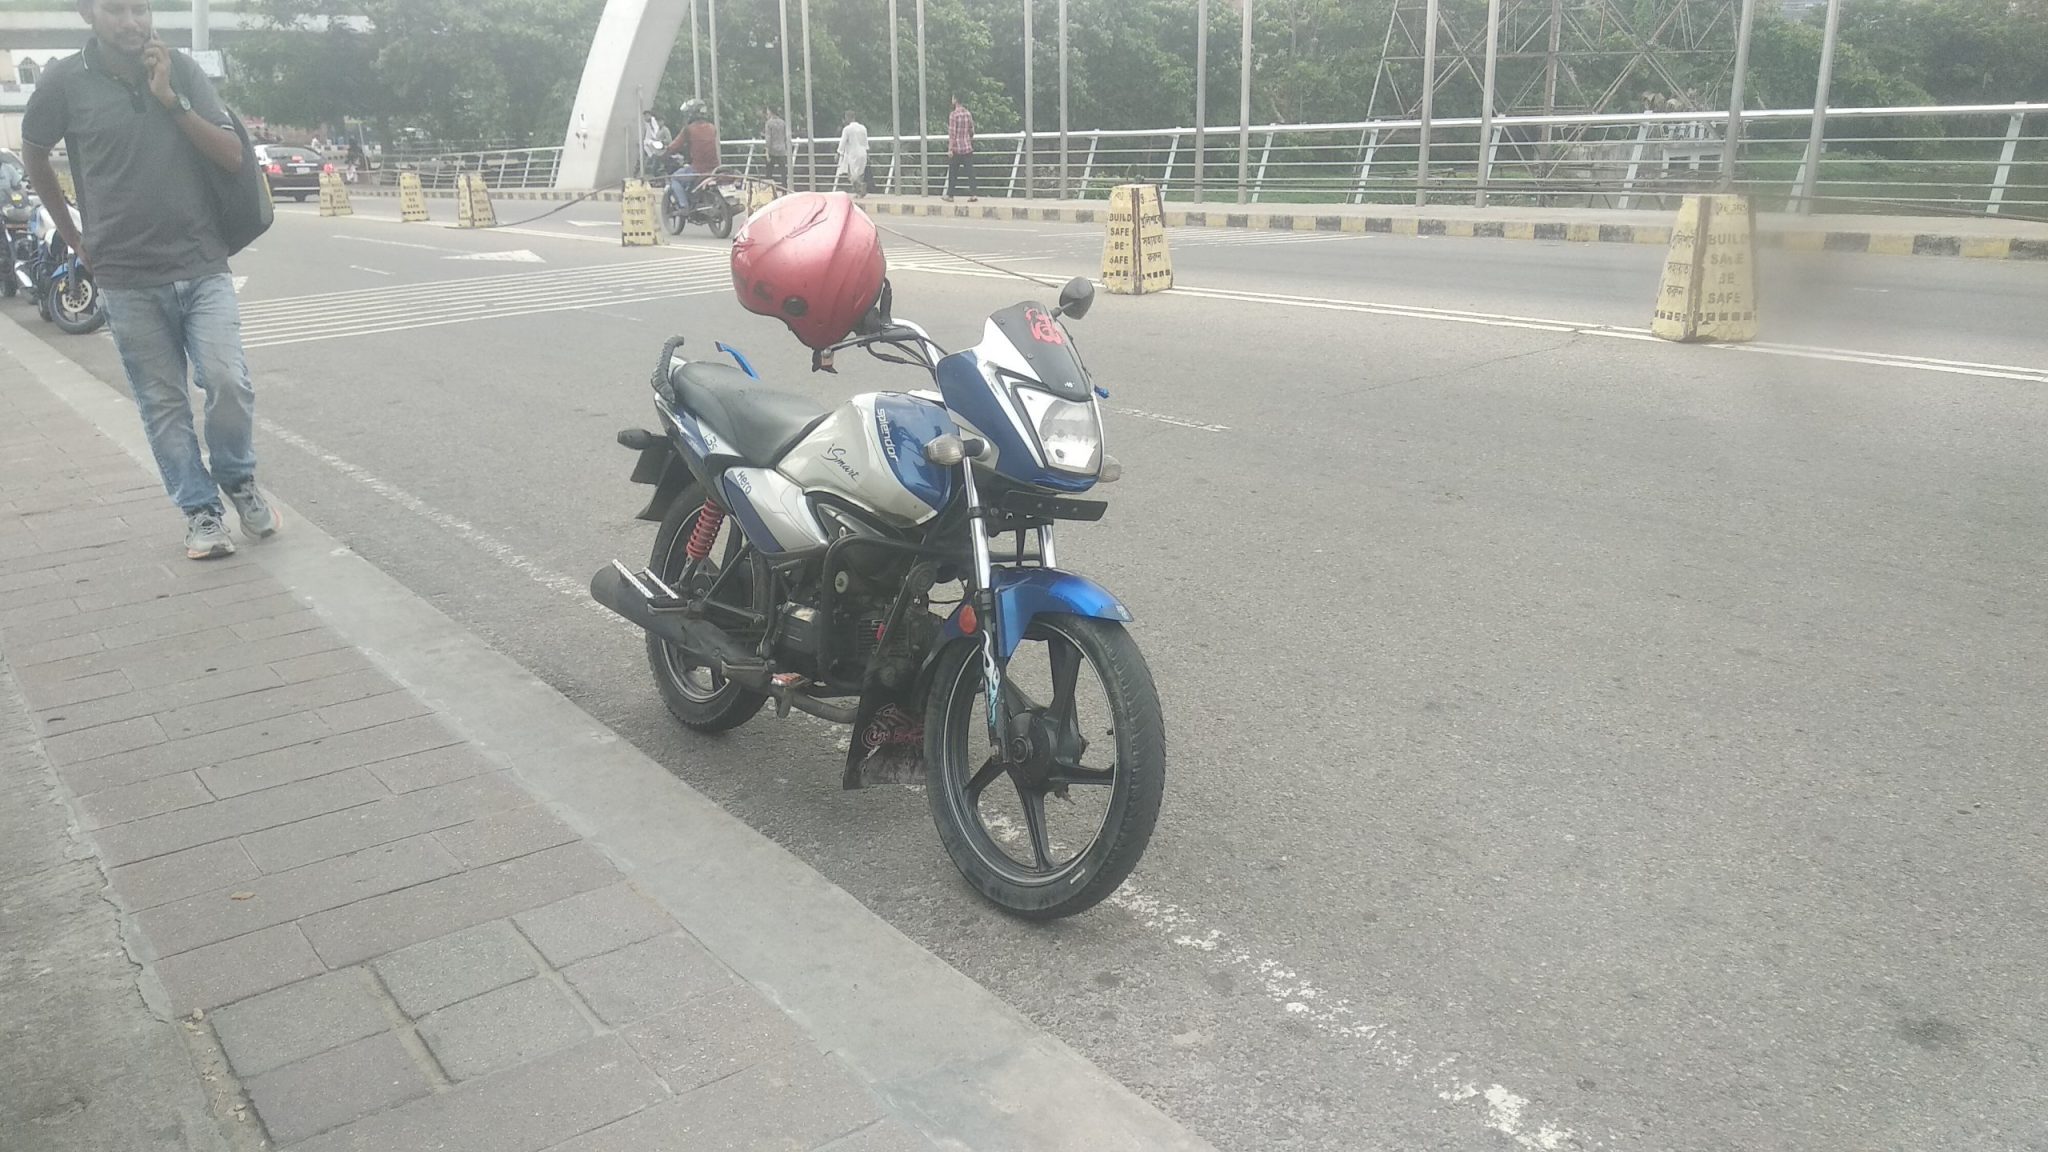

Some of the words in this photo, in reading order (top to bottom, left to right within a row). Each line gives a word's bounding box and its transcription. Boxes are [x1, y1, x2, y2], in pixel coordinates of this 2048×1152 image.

[1109, 213, 1132, 222] BUILD
[1110, 227, 1130, 236] SAFE
[1708, 234, 1748, 246] BUILD
[1109, 255, 1129, 265] SAFE
[1707, 293, 1741, 304] SAFE
[737, 470, 753, 496] Hero
